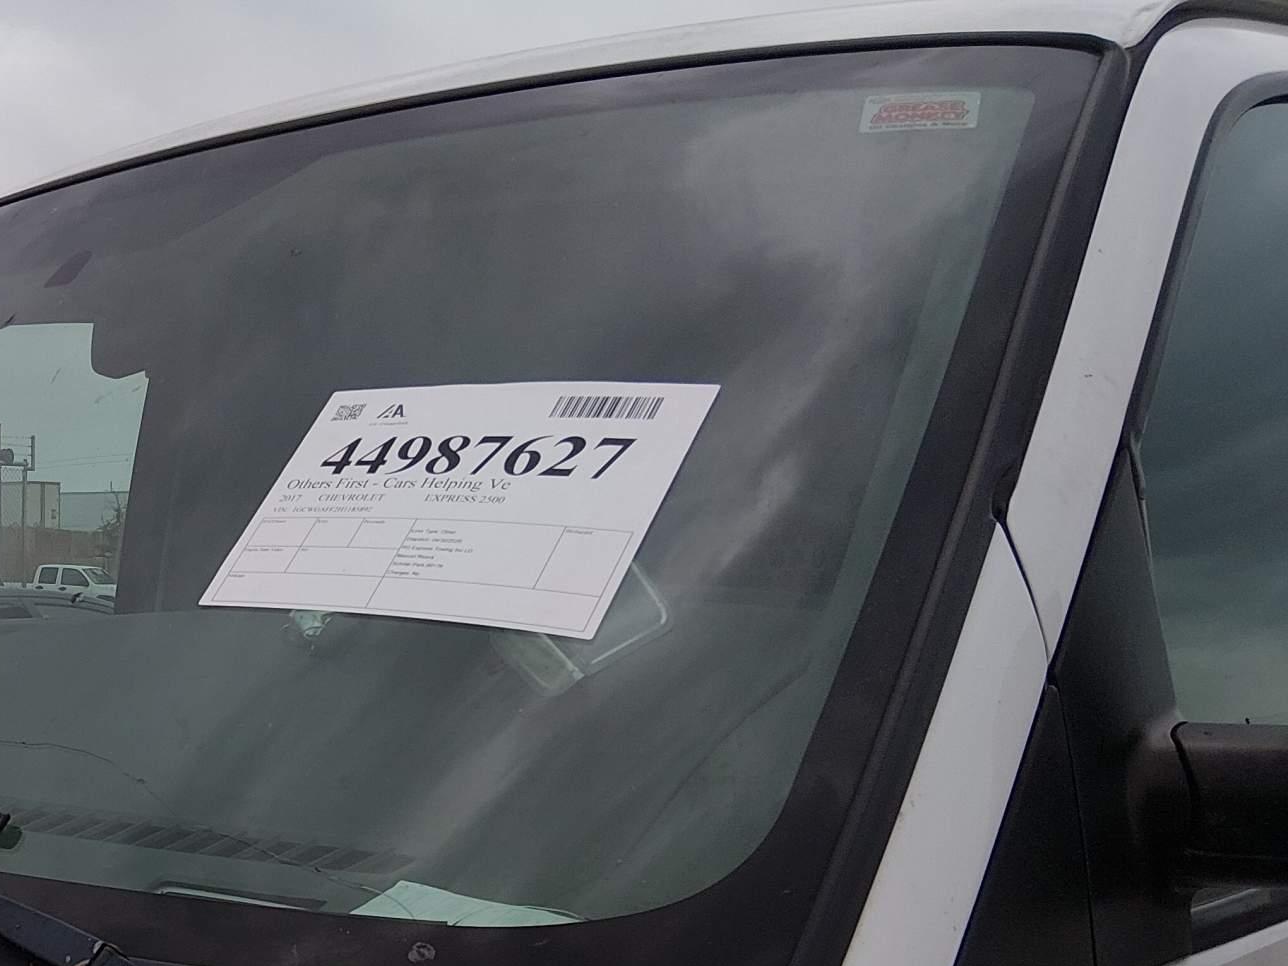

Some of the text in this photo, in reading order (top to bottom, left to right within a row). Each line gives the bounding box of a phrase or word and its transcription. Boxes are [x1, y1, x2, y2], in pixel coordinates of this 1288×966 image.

[320, 435, 638, 479] 44987627
[287, 478, 331, 490] Others
[335, 477, 369, 490] First
[383, 477, 415, 489] Cars
[421, 477, 483, 492] Helping
[490, 478, 511, 490] Ve
[279, 493, 507, 504] 2017 CHEVROLET EXPRESS 2500
